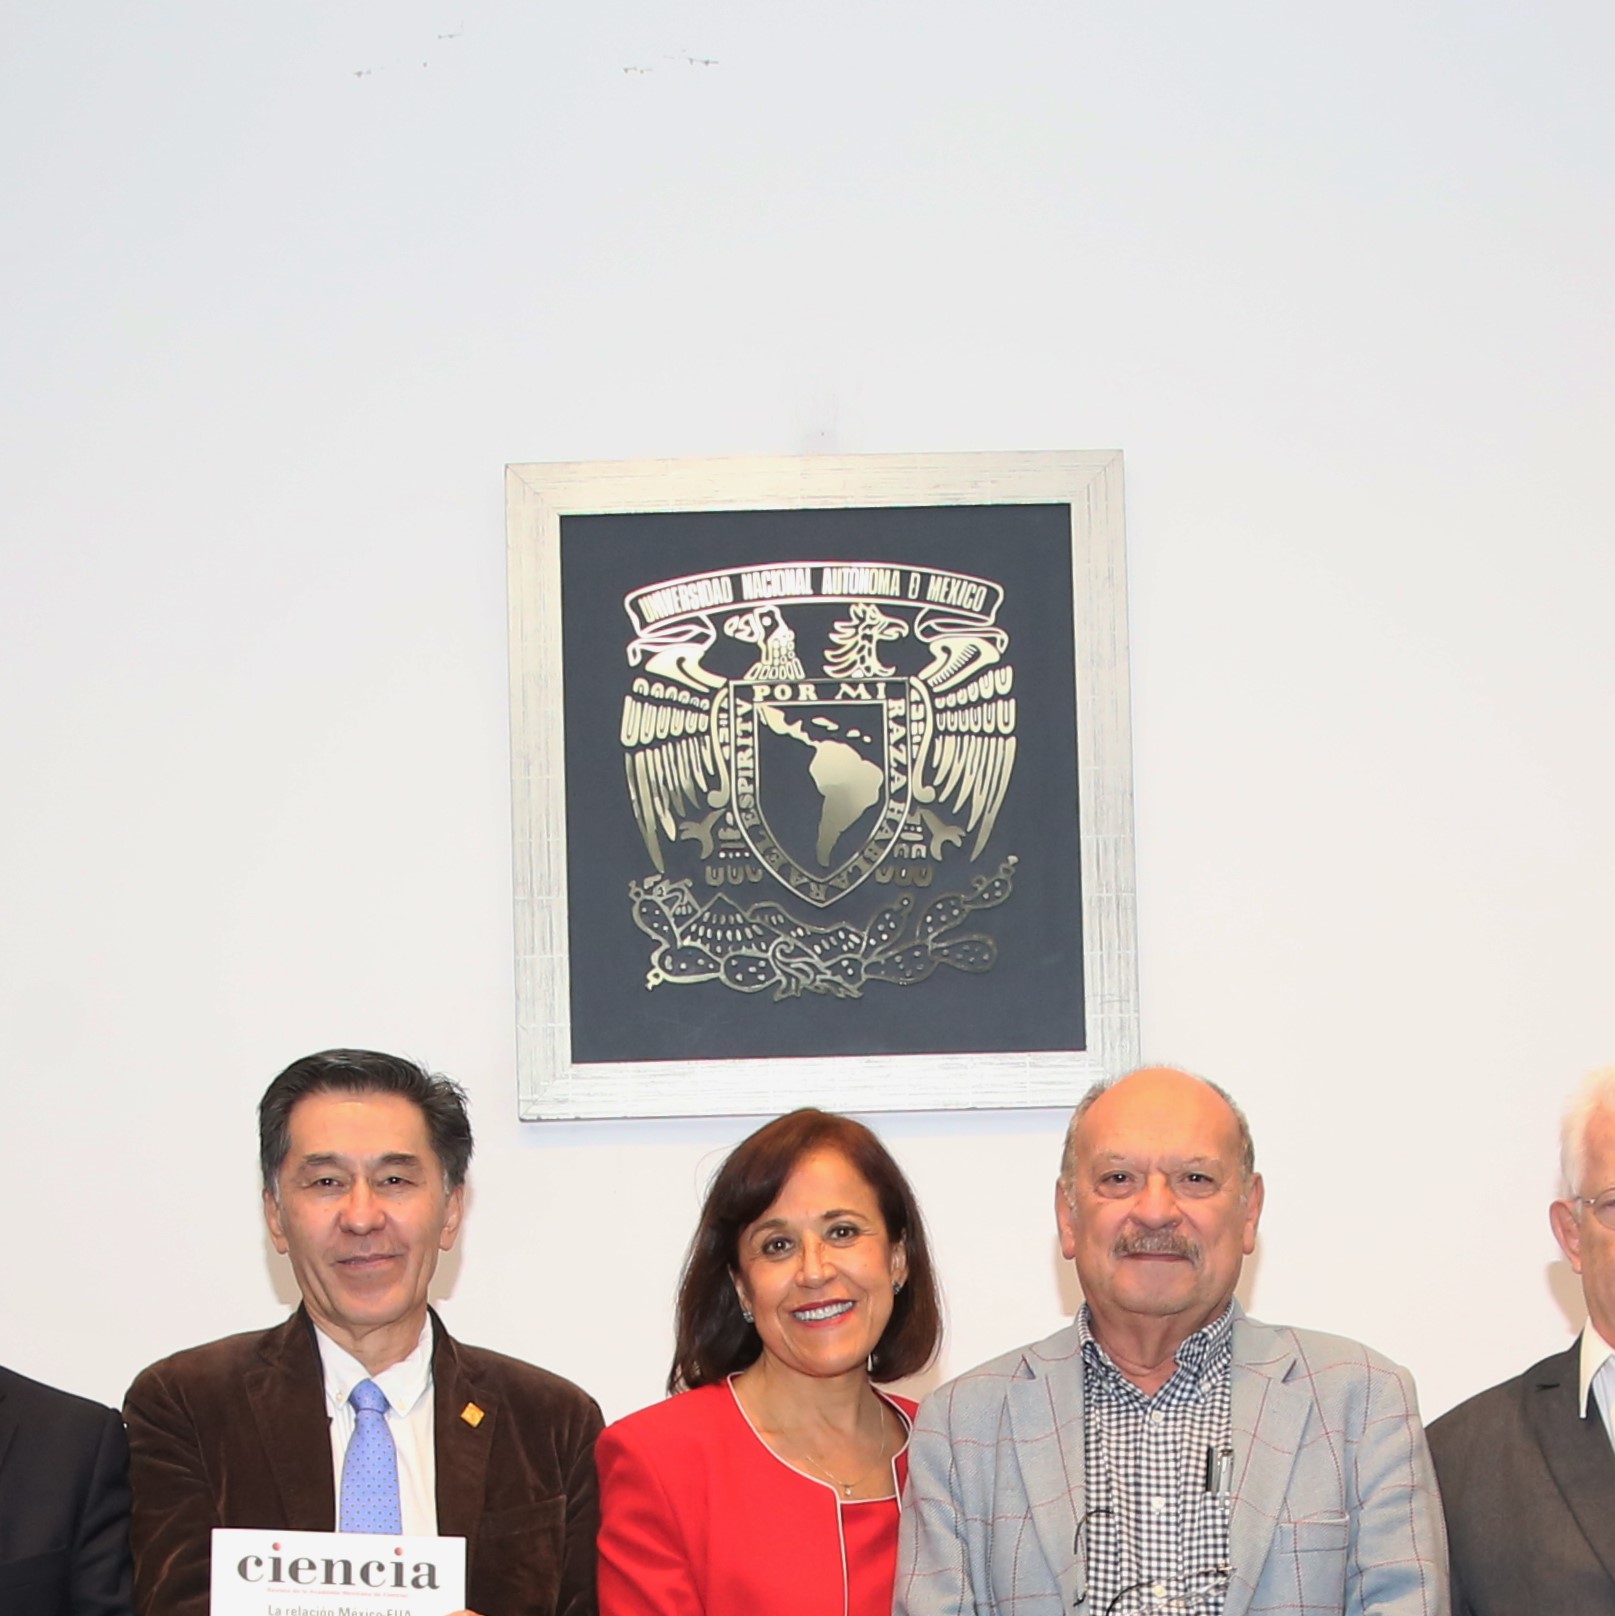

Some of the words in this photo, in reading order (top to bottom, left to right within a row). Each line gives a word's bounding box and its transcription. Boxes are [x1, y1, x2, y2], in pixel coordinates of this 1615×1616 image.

[639, 577, 733, 623] UNIVERSIDAD
[742, 568, 814, 600] NACIONAL
[822, 566, 900, 597] AUTONOMA
[927, 575, 988, 612] MEXICO
[753, 684, 817, 701] POR
[835, 682, 886, 700] MI
[888, 699, 907, 794] RAZA
[237, 1542, 440, 1590] ciencia
[268, 1605, 282, 1616] La
